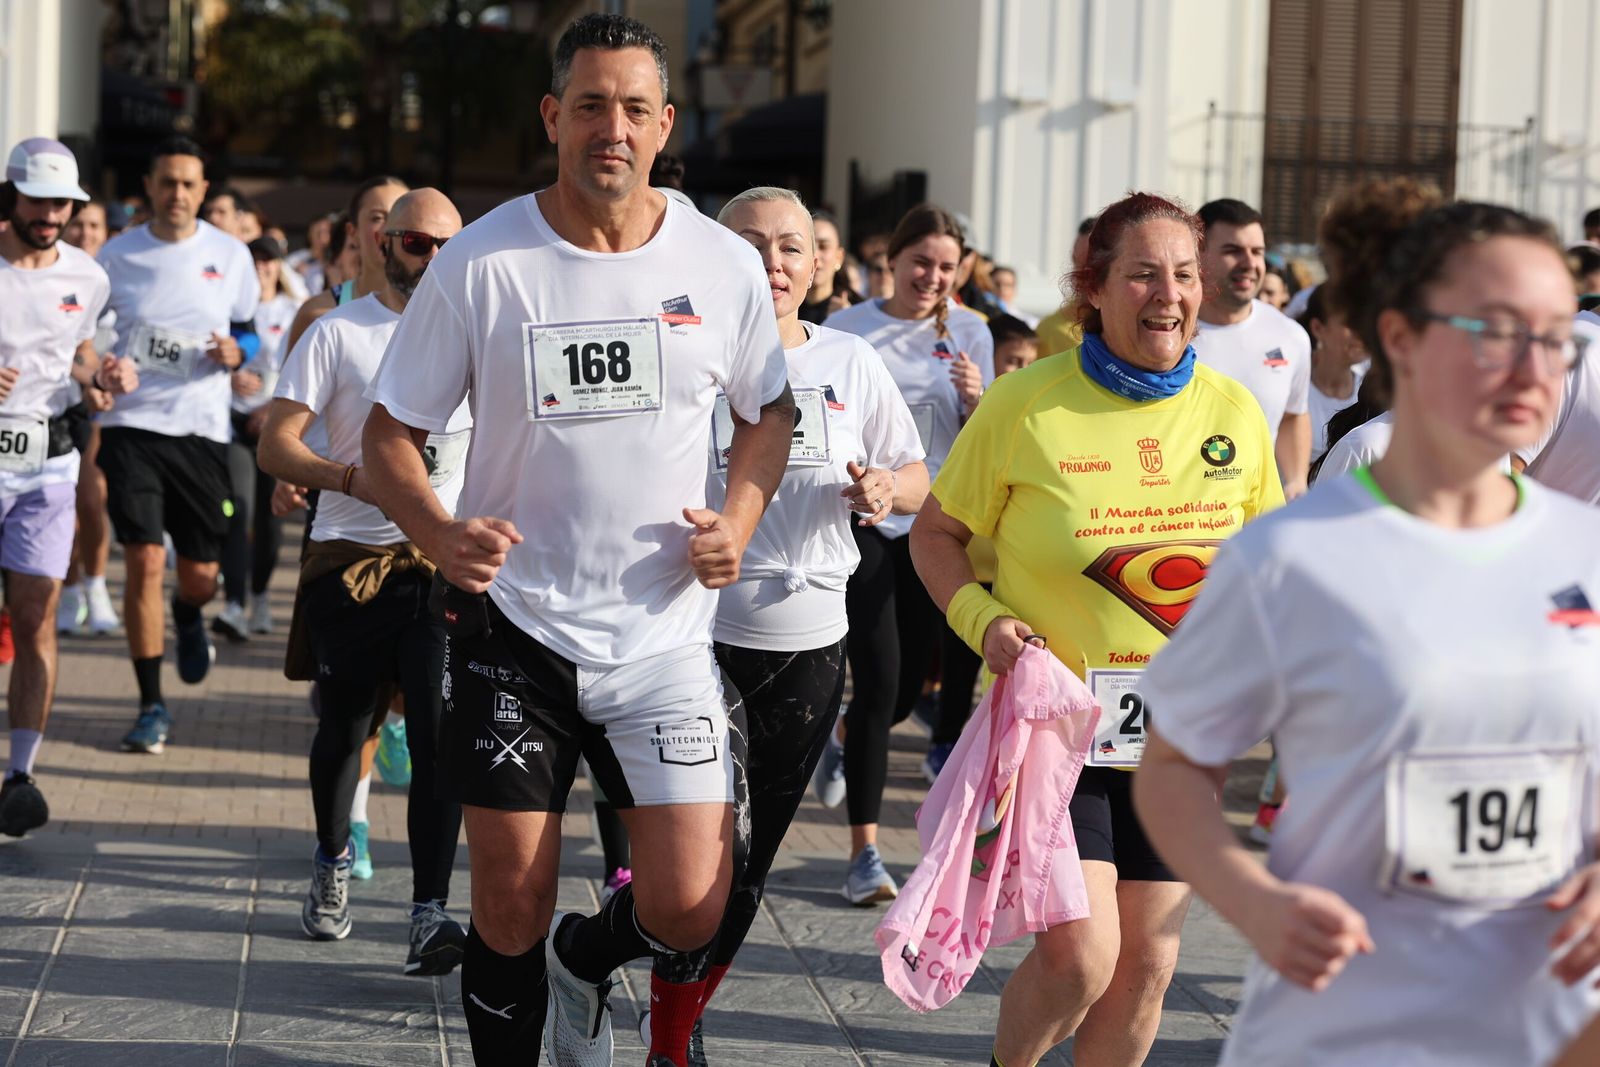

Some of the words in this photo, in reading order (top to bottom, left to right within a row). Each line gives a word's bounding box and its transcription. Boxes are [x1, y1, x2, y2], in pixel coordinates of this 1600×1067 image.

[662, 296, 688, 308] McArthur
[562, 341, 631, 385] 168
[1202, 435, 1232, 449] BMW
[1058, 460, 1112, 474] PROLONGO
[1203, 468, 1242, 478] AutoMotor
[1139, 478, 1171, 488] Deportes
[1090, 508, 1099, 520] II
[1104, 505, 1163, 518] Marcha
[1168, 500, 1227, 516] solidaria
[1074, 524, 1124, 538] contra
[1130, 522, 1145, 534] el
[1150, 519, 1195, 532] cáncer
[1198, 514, 1236, 532] infantil
[1108, 652, 1152, 664] Todos
[496, 710, 518, 719] arte
[474, 738, 494, 750] JIU
[520, 742, 544, 754] JITSU
[650, 736, 720, 746] SOILTECHNIQUE
[1450, 786, 1538, 854] 194
